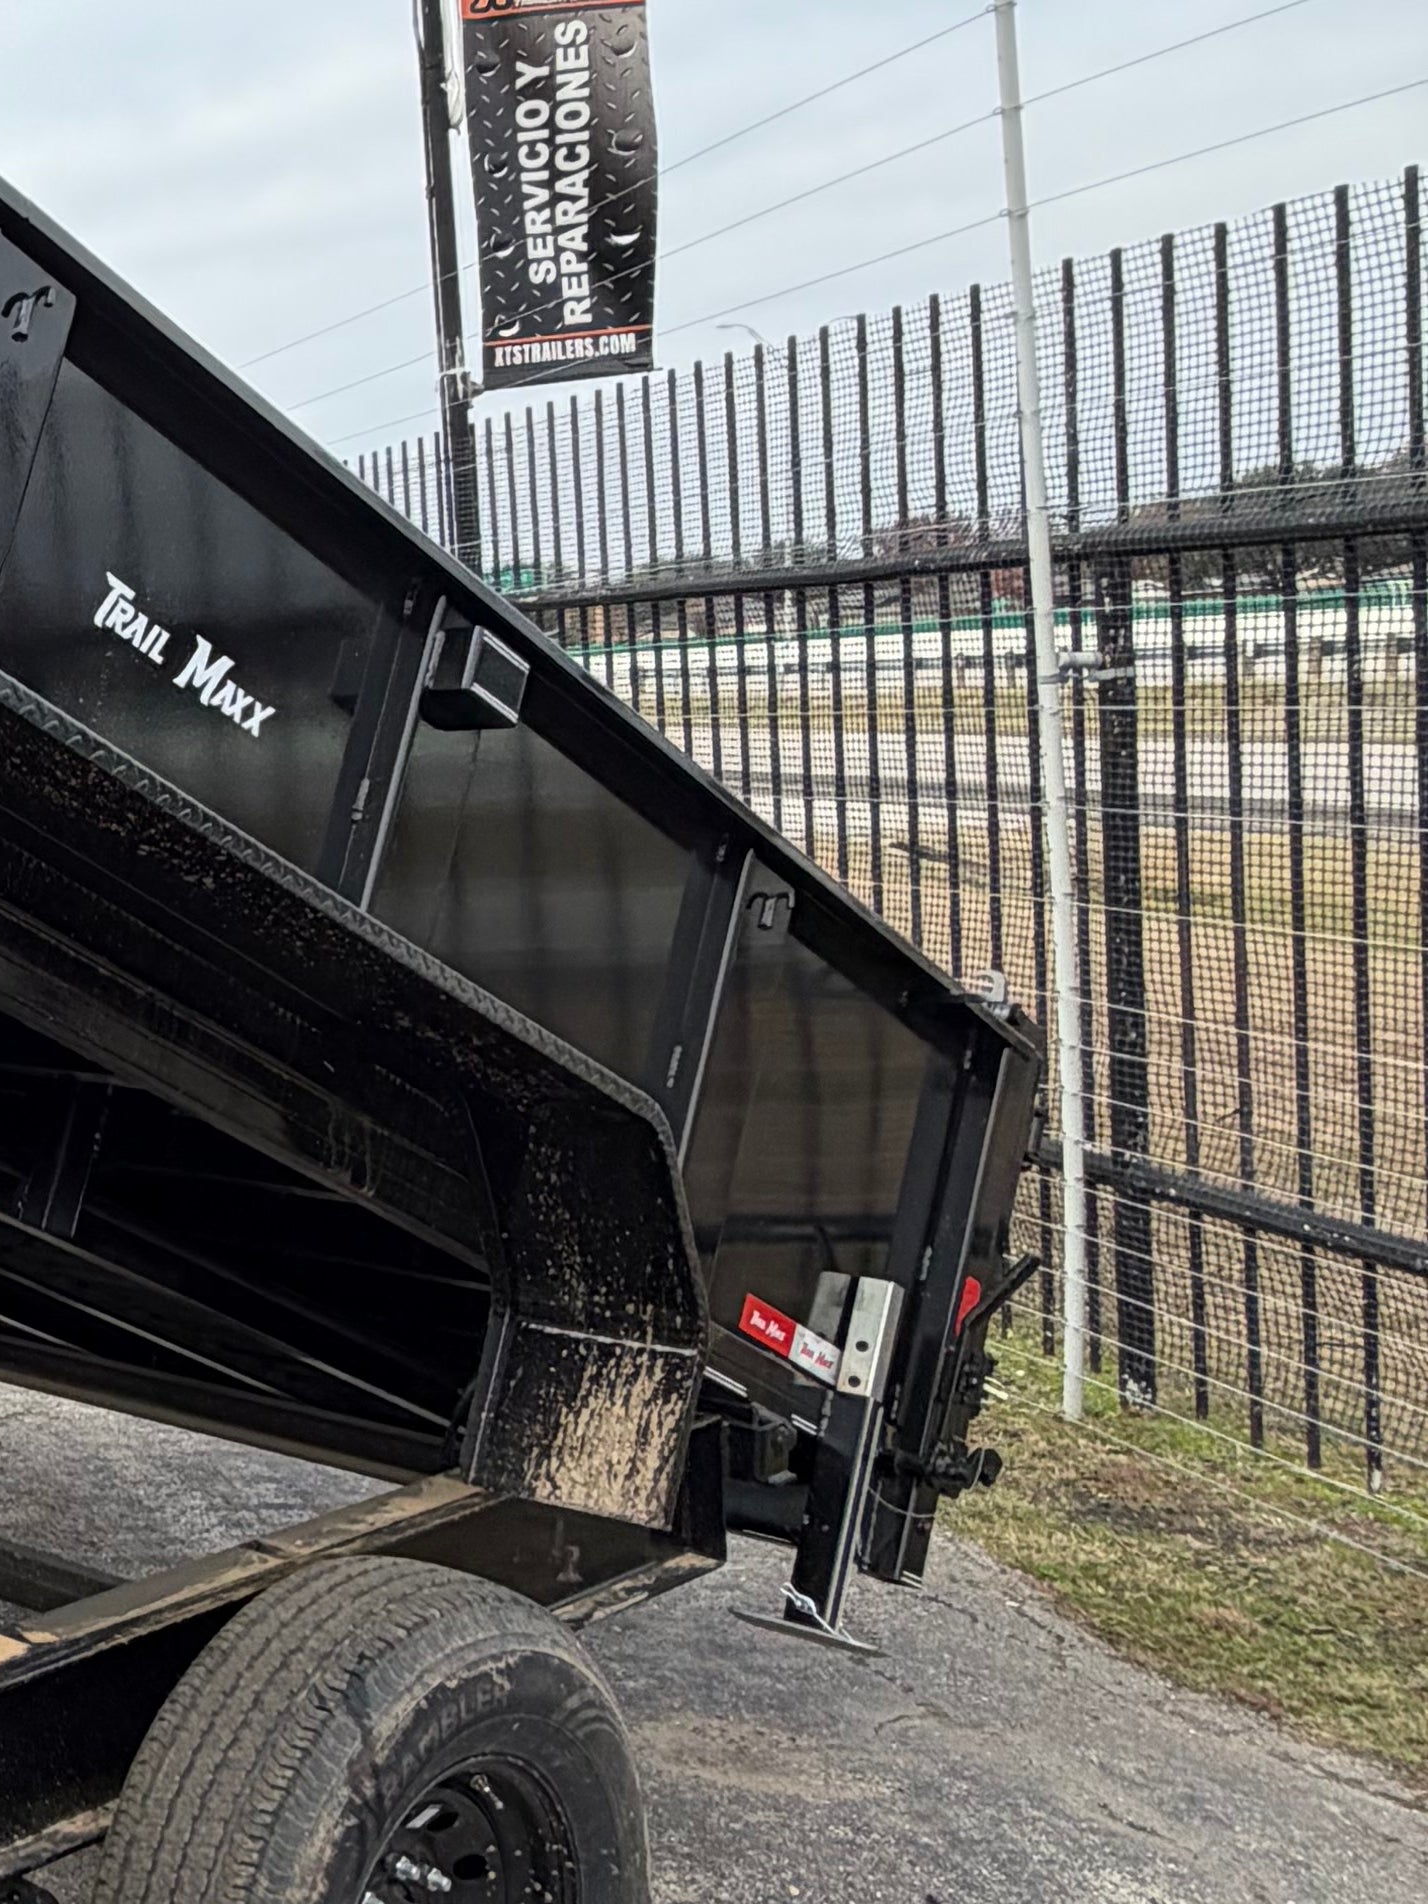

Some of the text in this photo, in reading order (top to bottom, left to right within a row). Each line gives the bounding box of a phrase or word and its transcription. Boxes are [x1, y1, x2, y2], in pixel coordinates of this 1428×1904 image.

[515, 61, 557, 285] SERVICIO Y
[555, 19, 593, 328] REPARACIONES
[494, 332, 637, 368] XTSTRAILERS.COM
[93, 571, 277, 738] TRAIL MAXX
